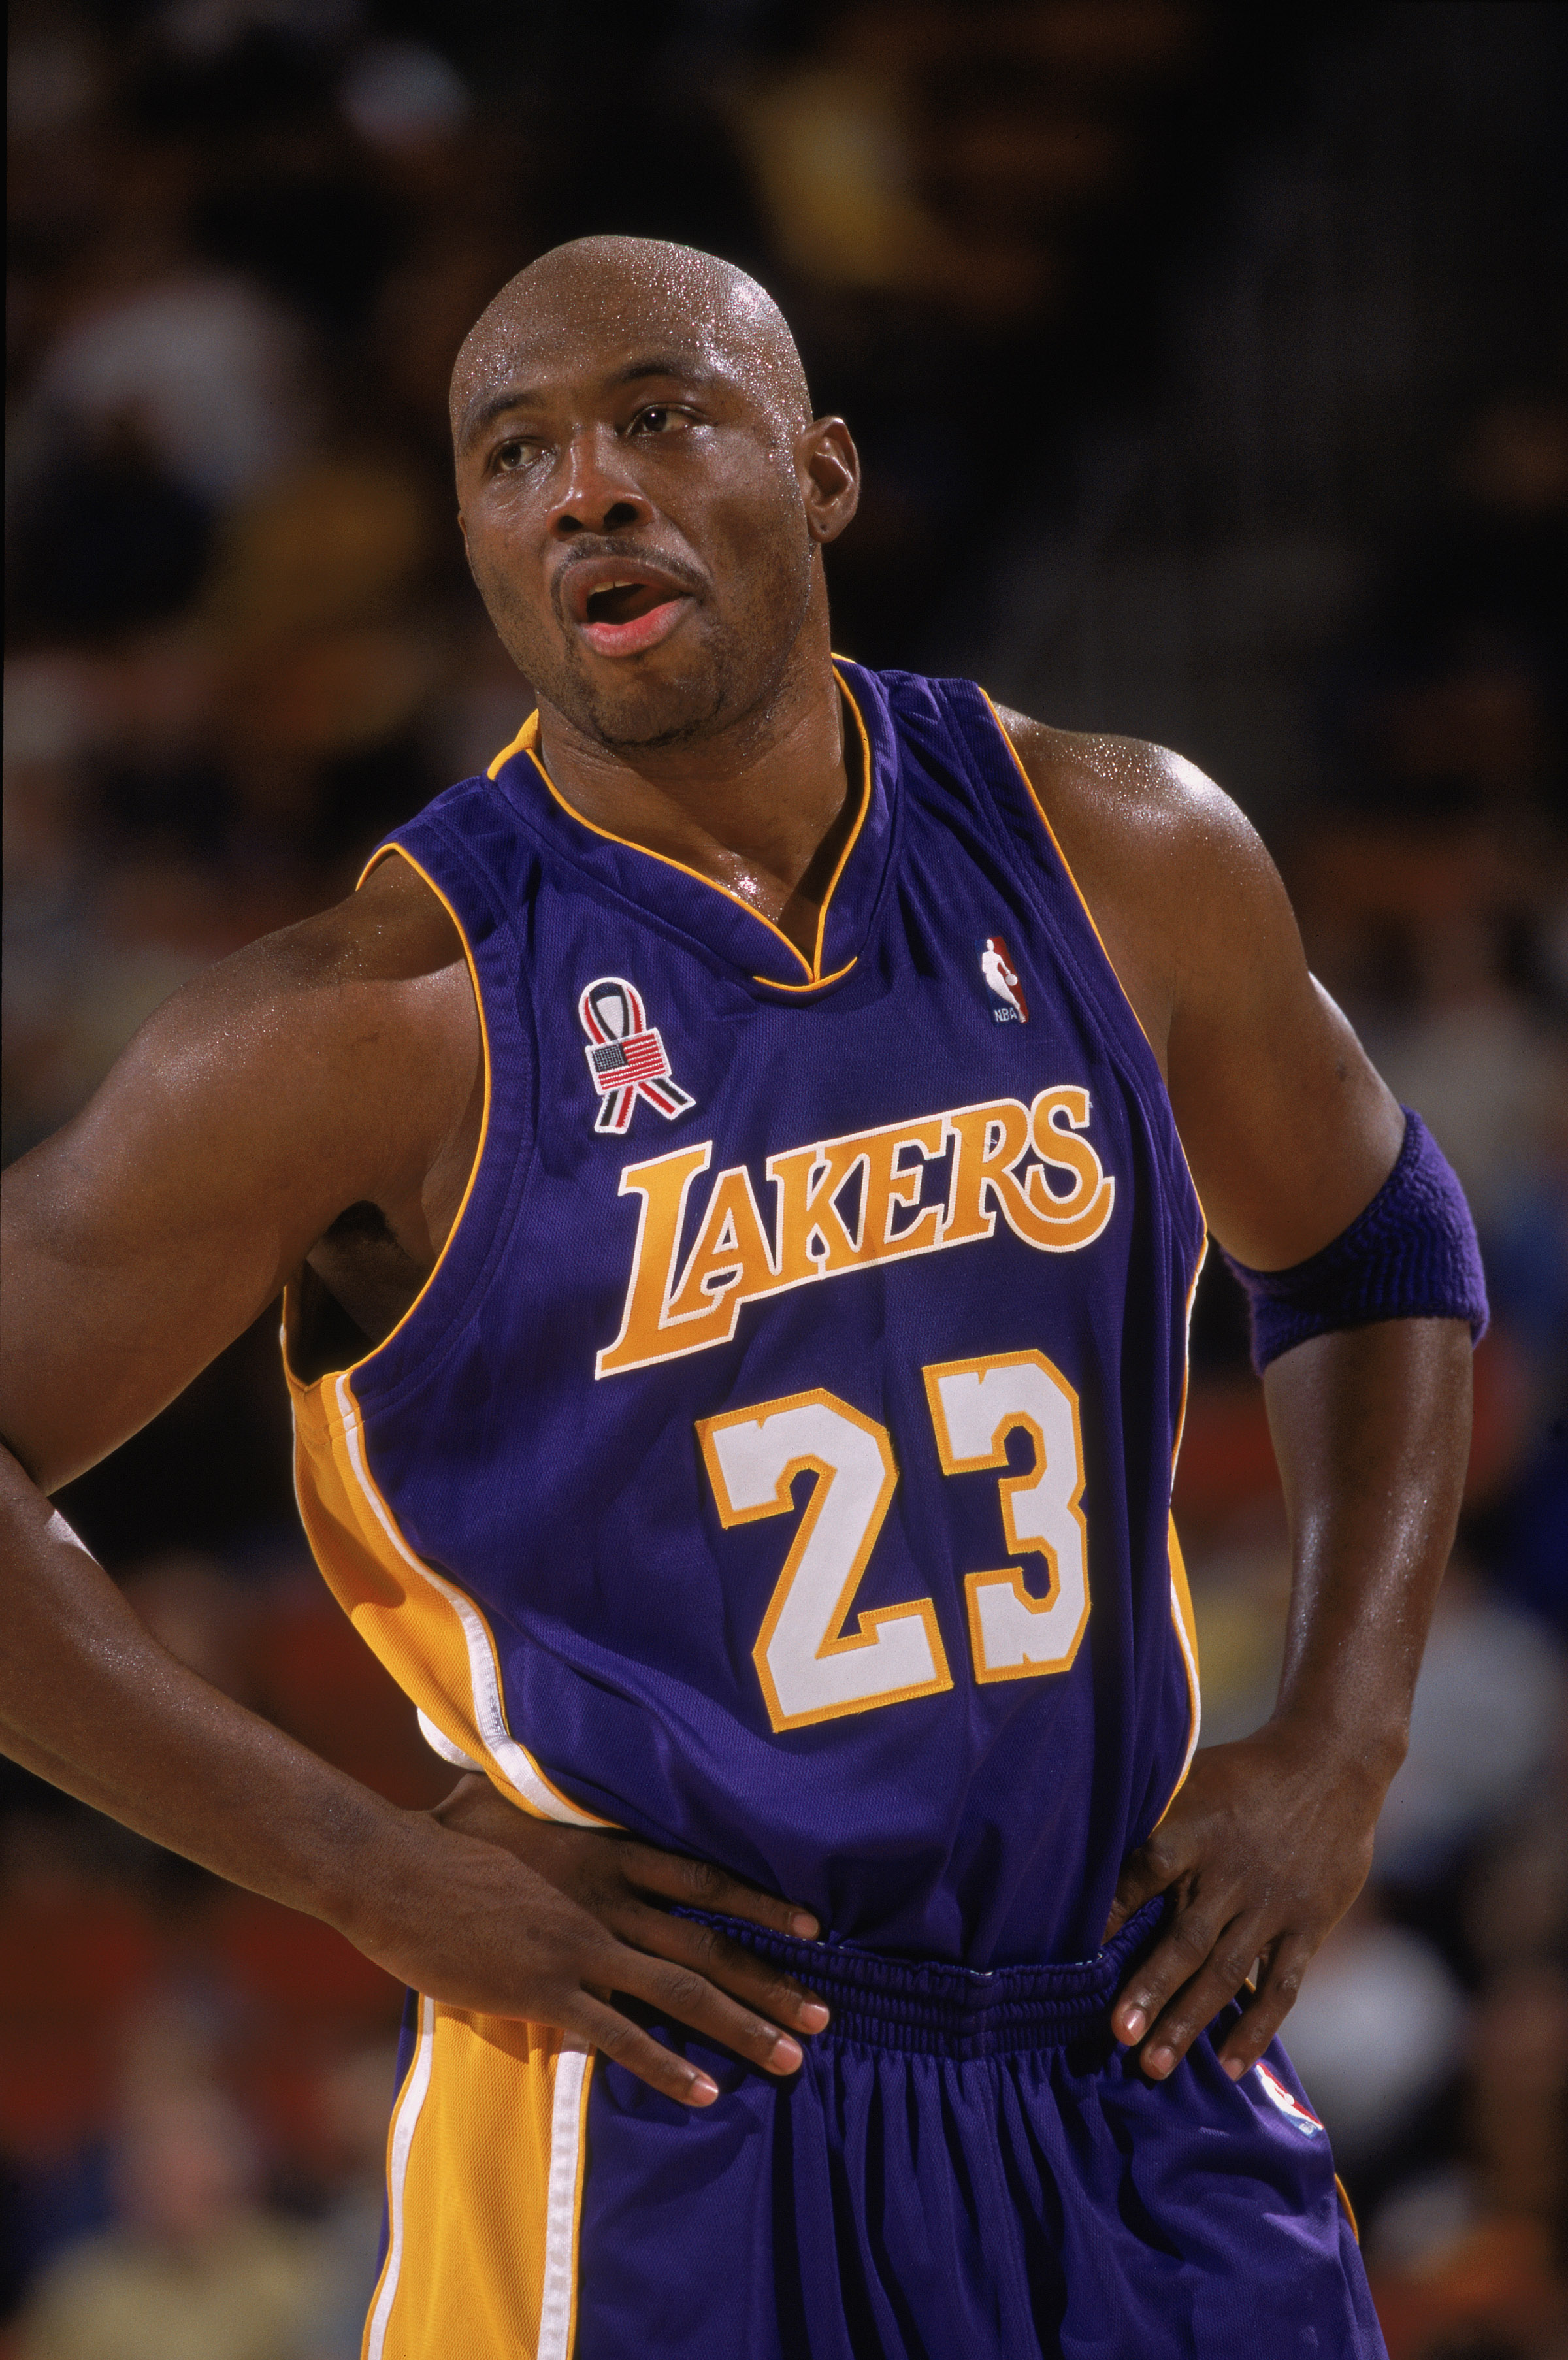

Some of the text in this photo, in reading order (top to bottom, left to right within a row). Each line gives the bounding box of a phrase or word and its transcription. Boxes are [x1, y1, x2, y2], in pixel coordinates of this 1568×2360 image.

[994, 1008, 1017, 1023] NBA
[595, 1085, 1115, 1380] LAKERS
[695, 1349, 1092, 1733] 23
